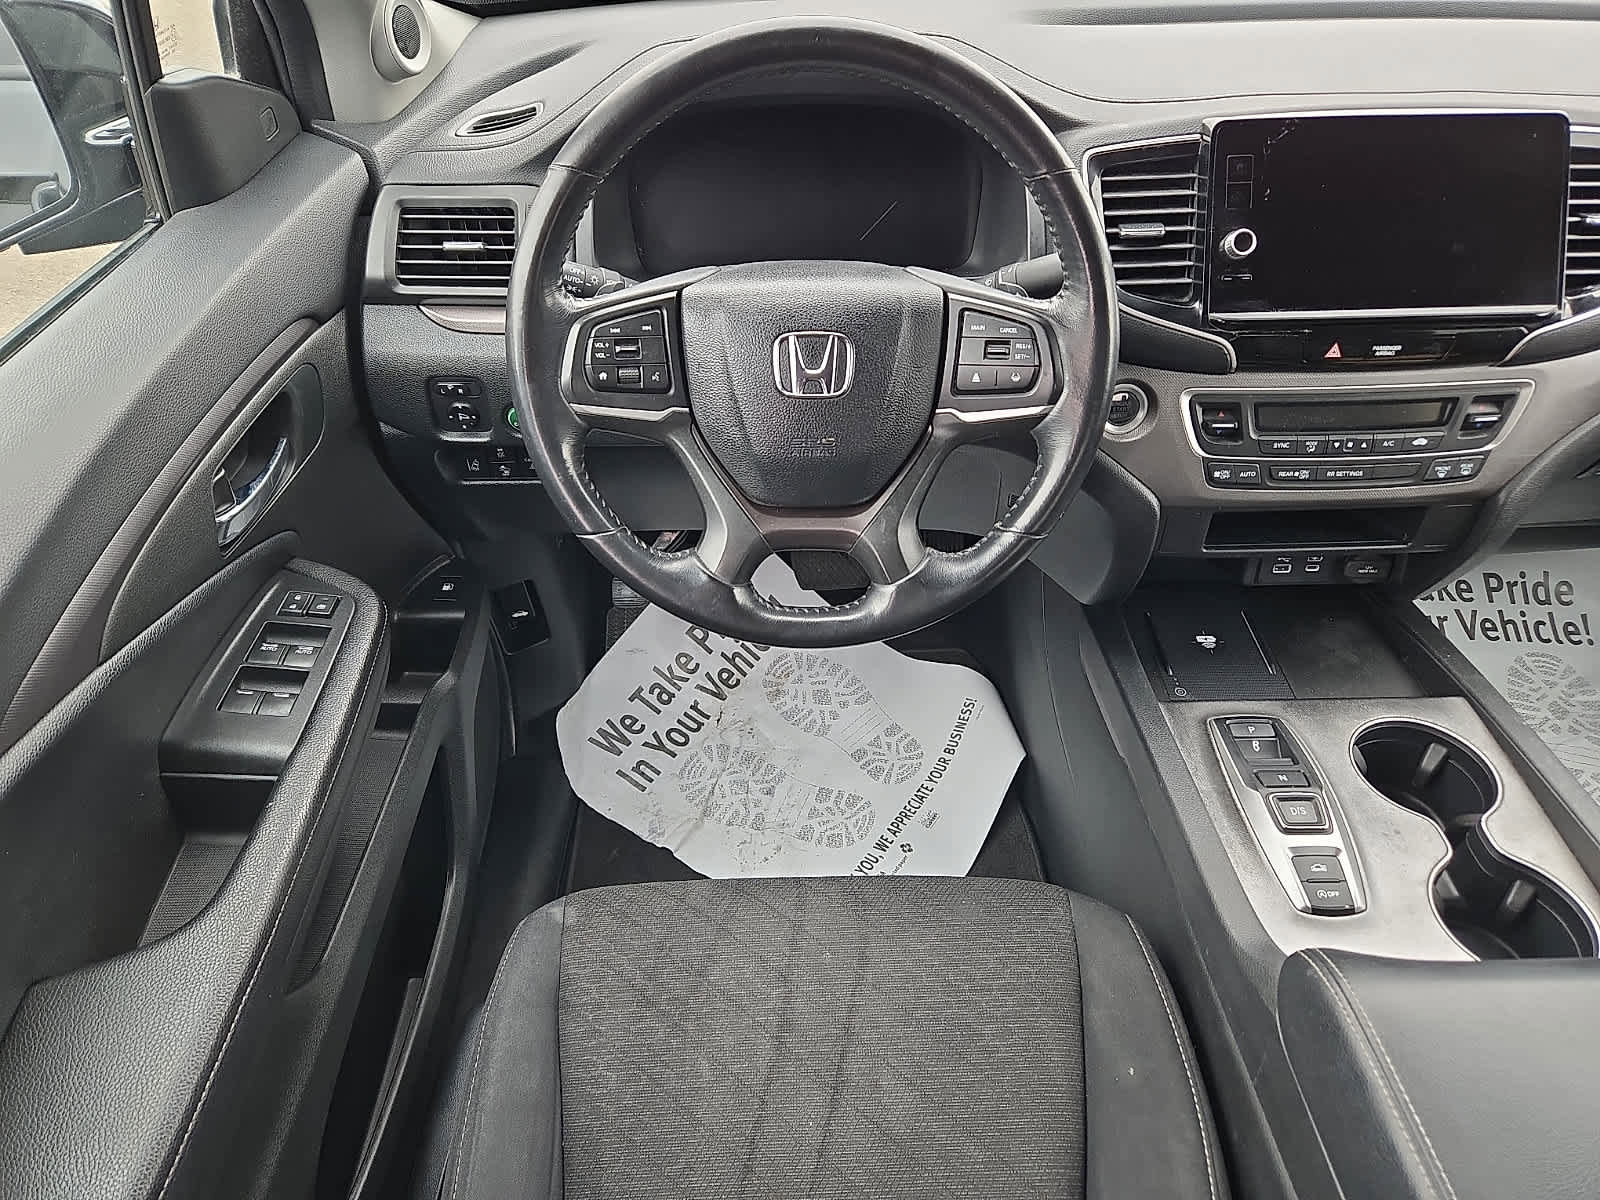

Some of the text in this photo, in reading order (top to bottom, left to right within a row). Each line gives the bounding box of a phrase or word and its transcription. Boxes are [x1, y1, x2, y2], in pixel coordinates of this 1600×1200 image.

[1273, 441, 1290, 449] SYNC
[1482, 571, 1574, 606] Pride
[1454, 608, 1595, 646] Vehicle!
[587, 651, 700, 757] We Take
[1247, 726, 1255, 734] P
[615, 759, 662, 793] In
[641, 699, 712, 759] Your
[854, 852, 885, 876] YOU,
[873, 834, 895, 853] WE
[886, 783, 935, 838] APPRECIATE
[925, 756, 952, 786] YOUR
[943, 697, 977, 758] BUSINESS!
[1277, 774, 1289, 782] N
[1289, 806, 1306, 816] D/S
[1327, 890, 1340, 898] OFF
